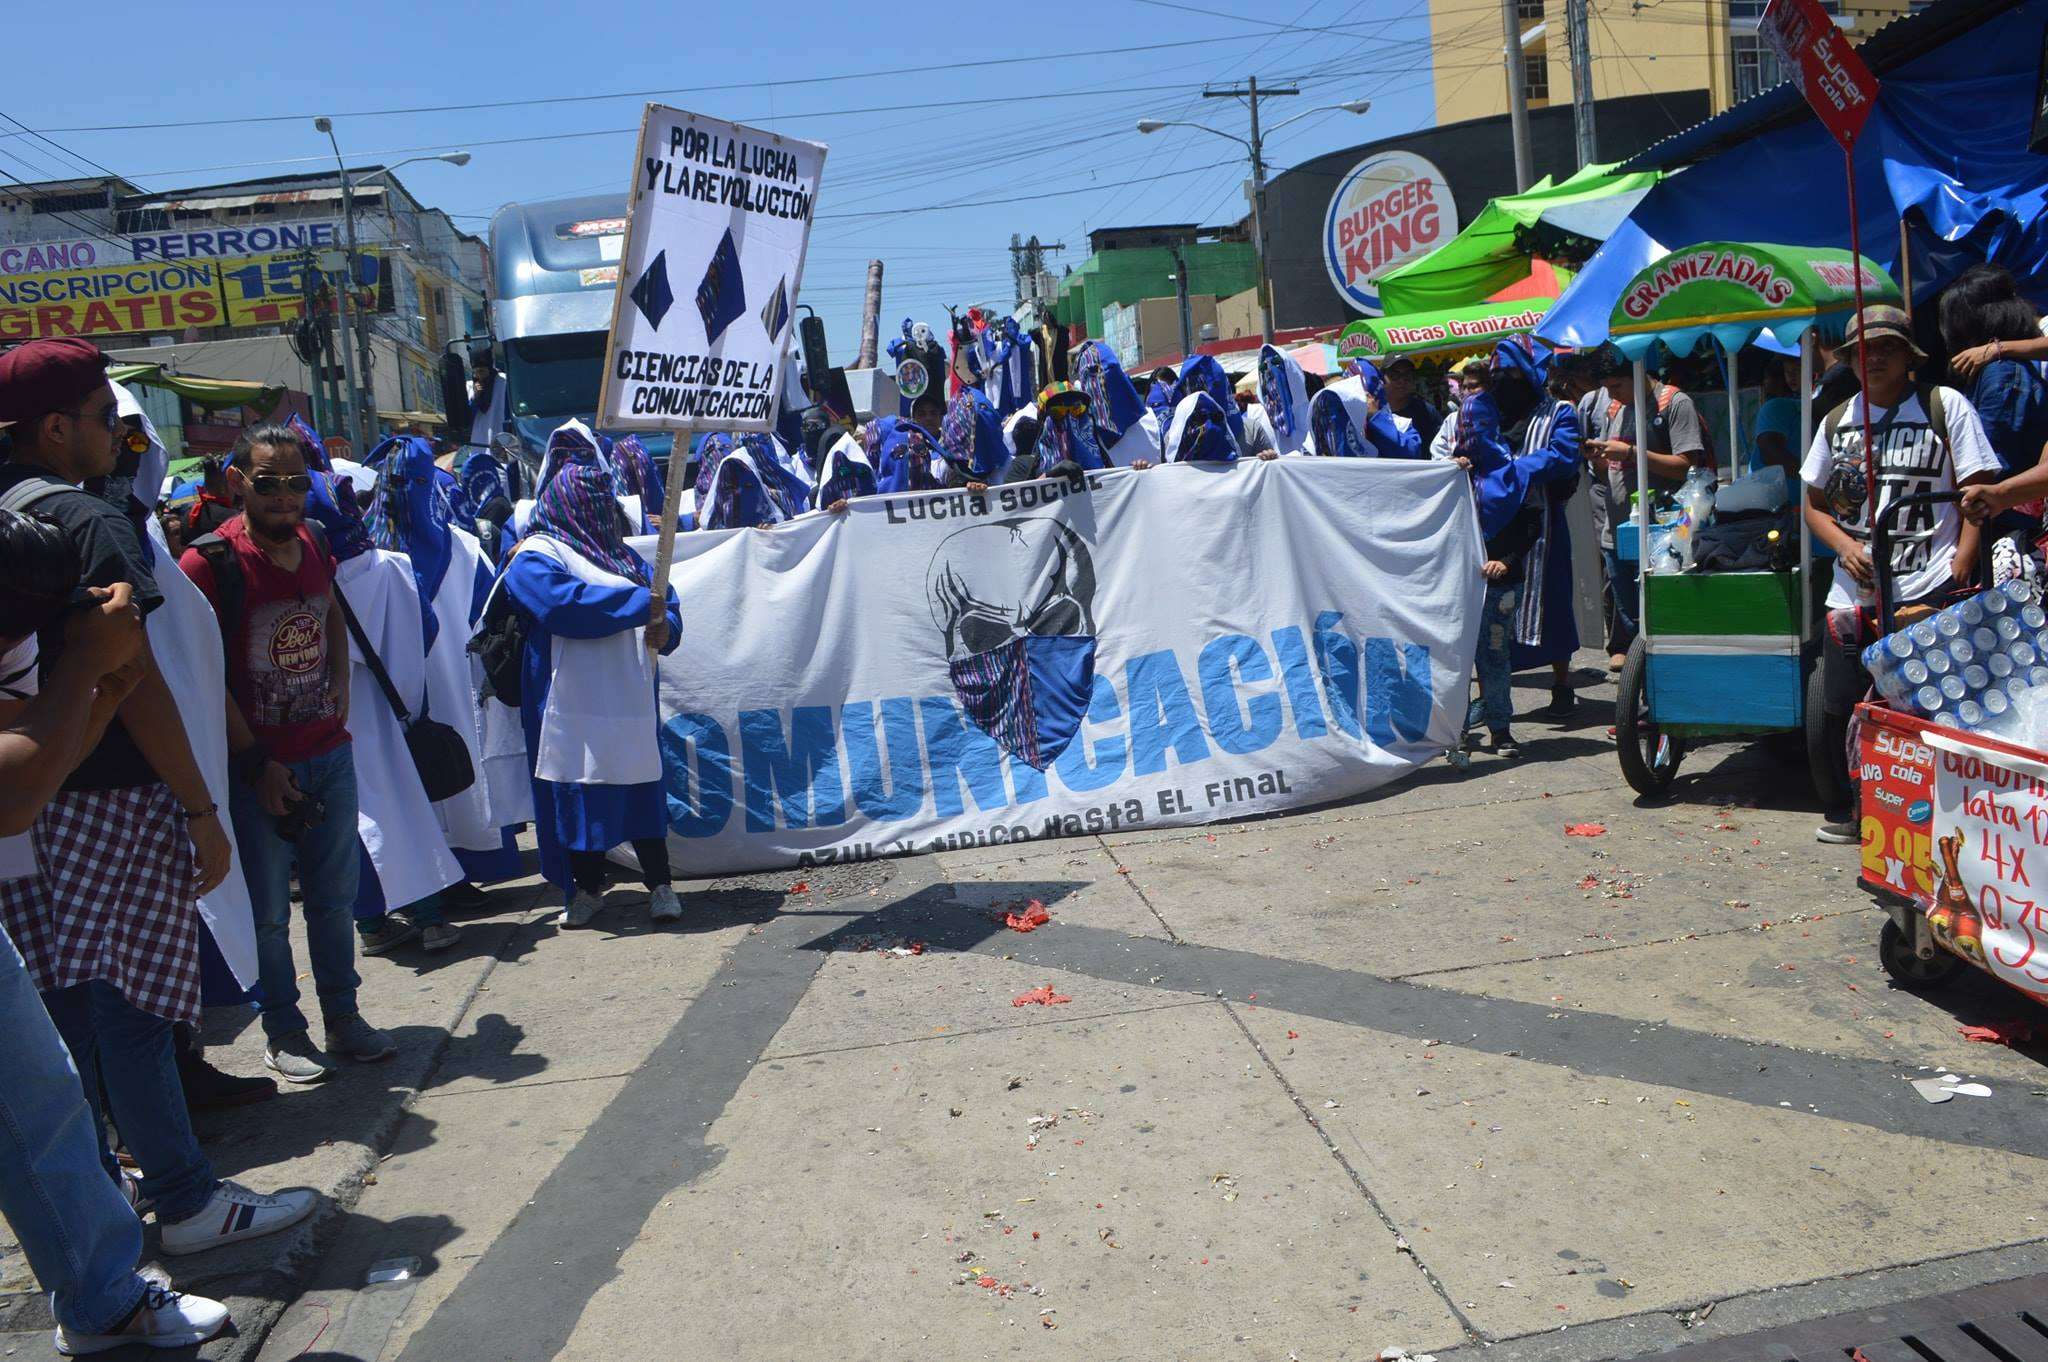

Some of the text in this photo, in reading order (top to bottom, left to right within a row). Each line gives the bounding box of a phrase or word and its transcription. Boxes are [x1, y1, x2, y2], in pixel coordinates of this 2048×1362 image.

[671, 126, 797, 184] POR LA LUCHA
[646, 157, 812, 221] Y LA REVOLUCIÓN
[1338, 177, 1433, 249] BURGER
[1, 223, 333, 274] CANO PERRONE
[1345, 203, 1440, 286] KING
[1624, 252, 1792, 317] GRANIZADAS
[0, 291, 217, 338] GRATIS
[1386, 325, 1446, 345] Ricas
[617, 350, 773, 390] CIENCIAS DE LA
[632, 386, 775, 420] COMUNICACIÓN
[1875, 787, 1904, 806] Super
[1890, 764, 1923, 785] cola
[1156, 789, 1193, 815] EL
[1963, 785, 2022, 832] lata
